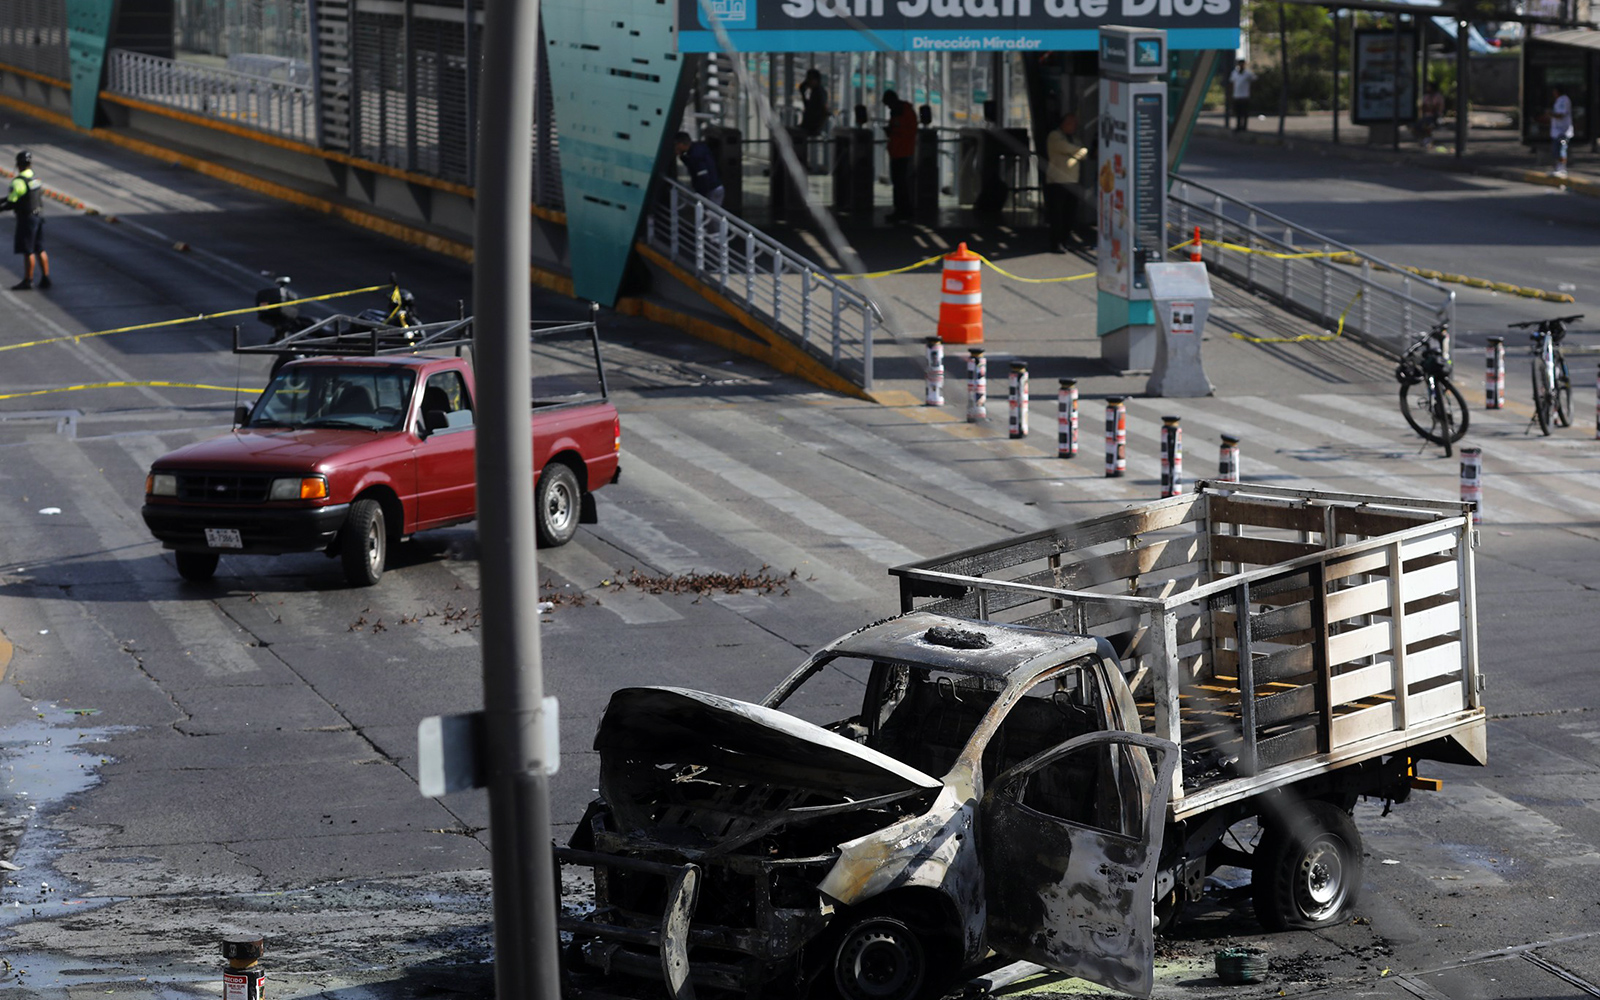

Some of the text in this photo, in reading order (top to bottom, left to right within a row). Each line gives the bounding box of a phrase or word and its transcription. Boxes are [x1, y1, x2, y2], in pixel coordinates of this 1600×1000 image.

[781, 0, 1231, 18] San Juan de Dios
[912, 36, 1041, 49] Dirección Mirador
